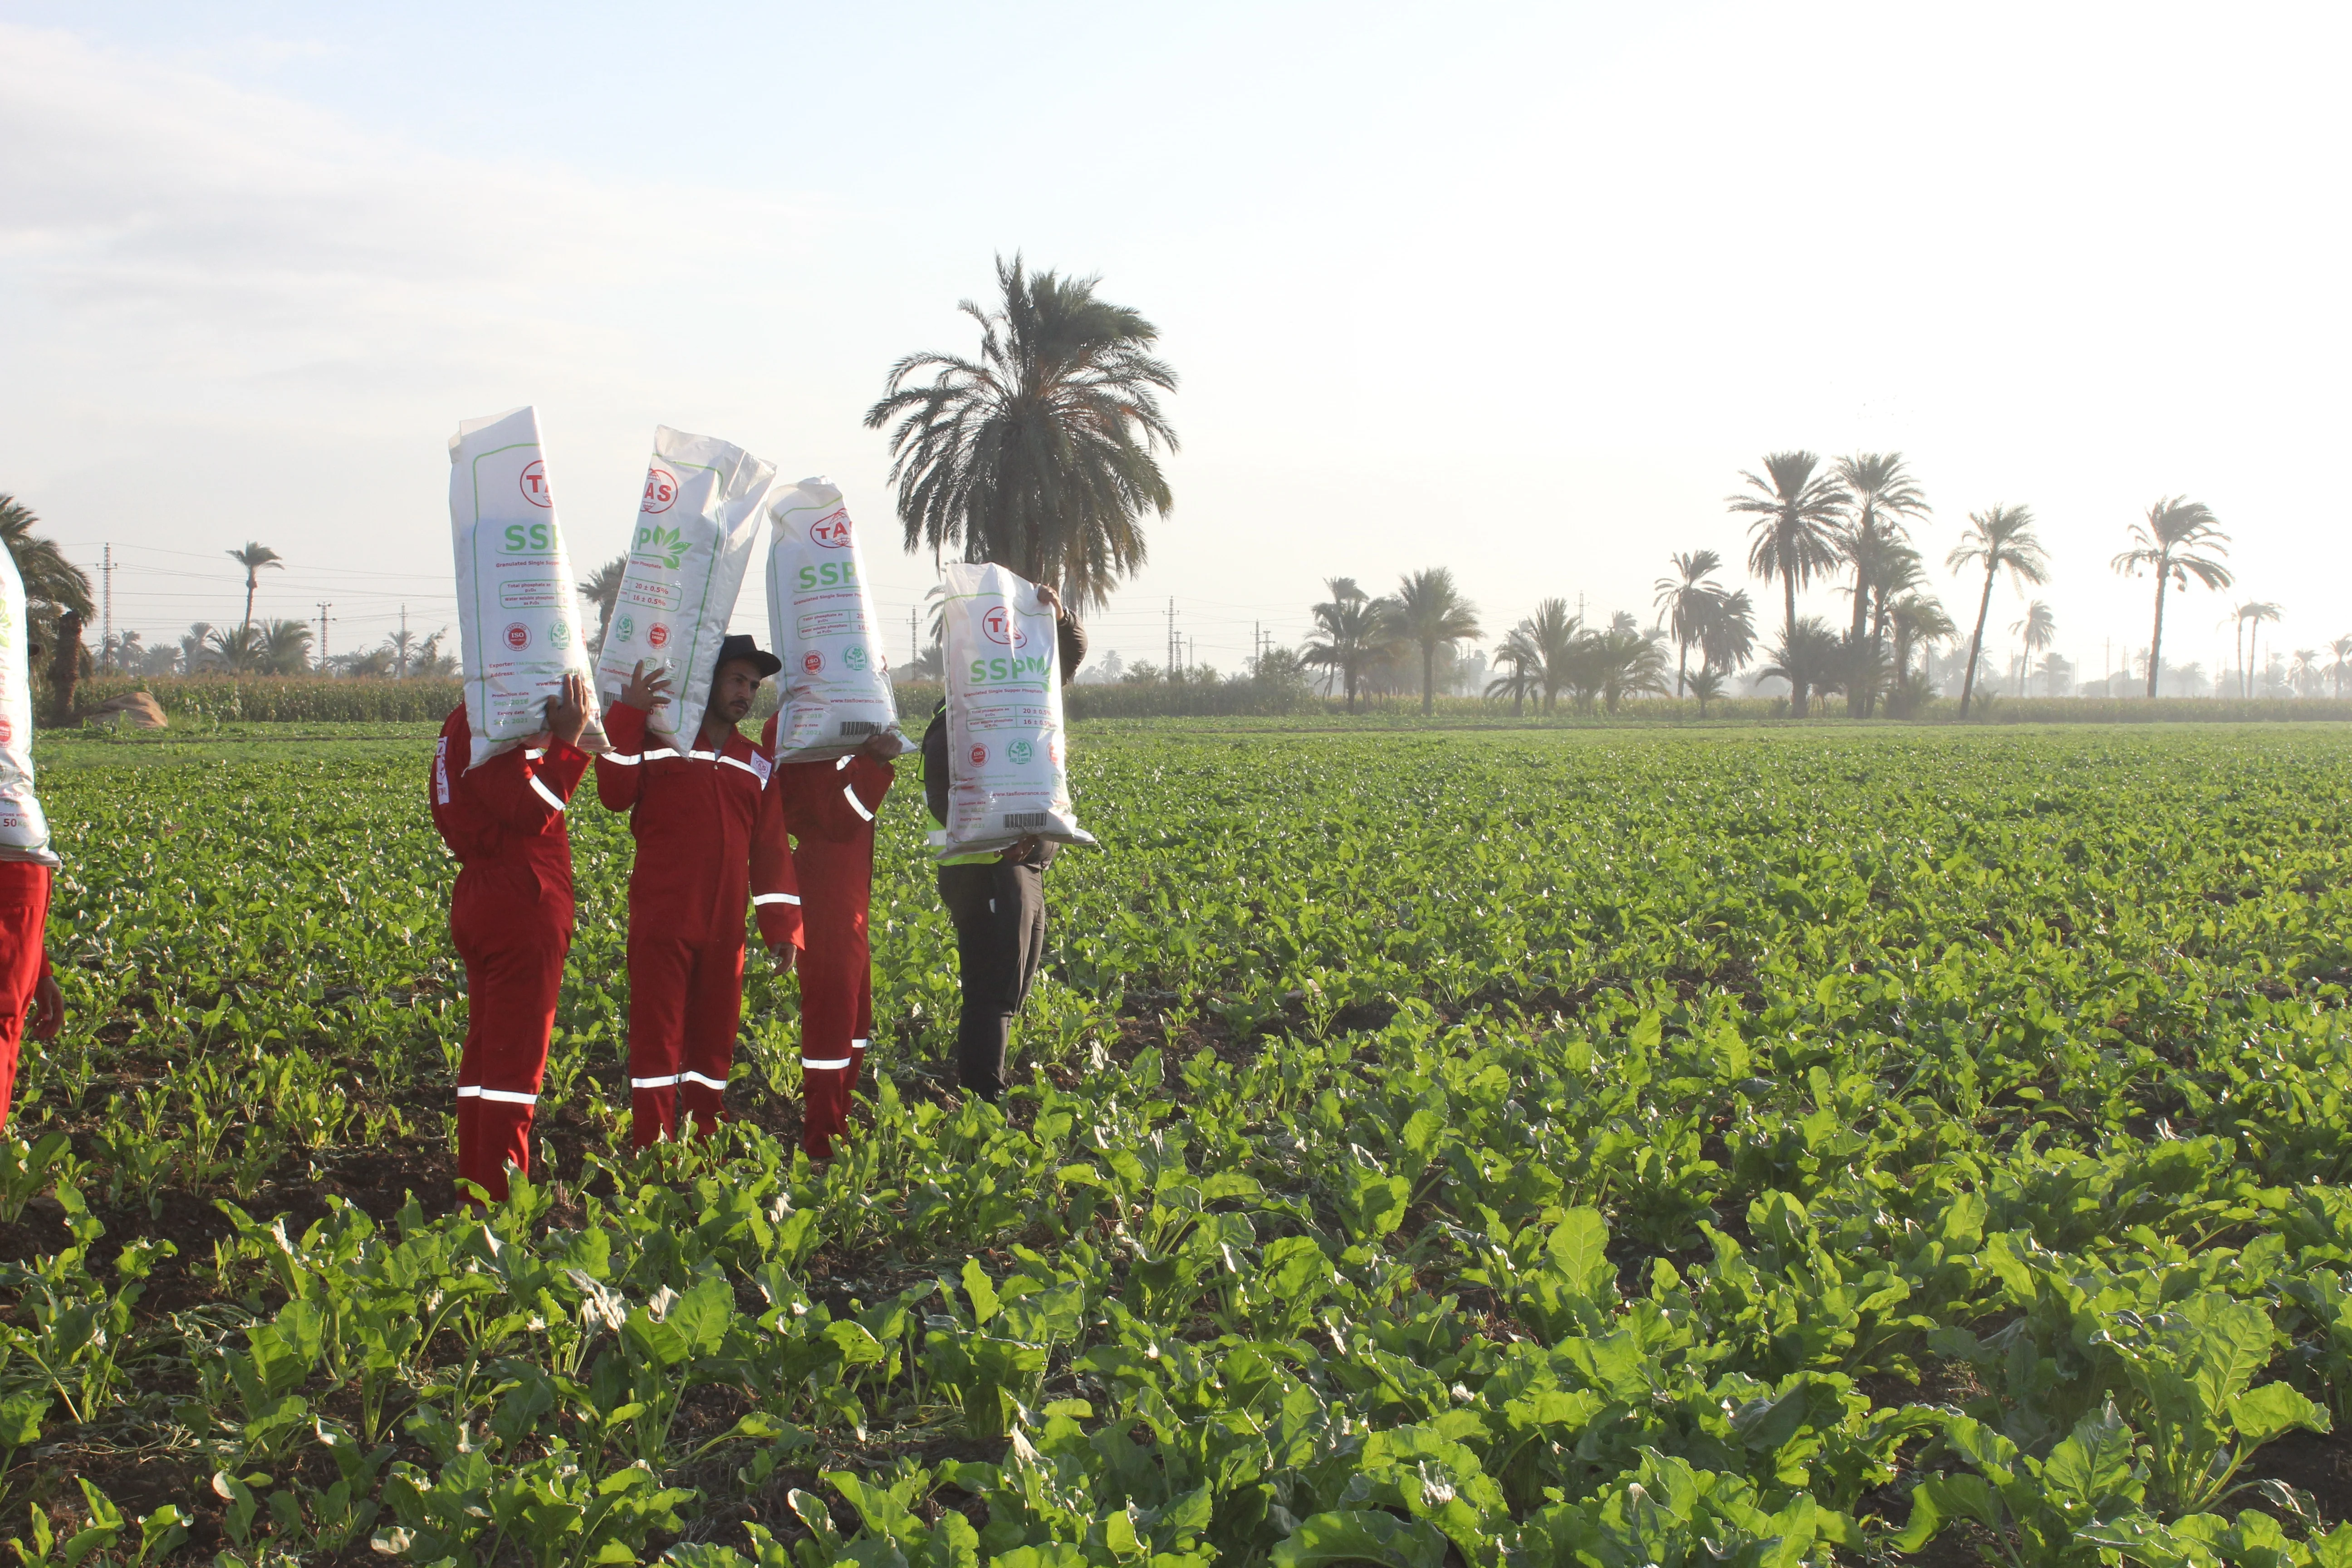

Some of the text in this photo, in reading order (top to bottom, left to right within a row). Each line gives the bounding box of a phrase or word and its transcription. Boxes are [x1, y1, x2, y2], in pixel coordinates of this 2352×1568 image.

[644, 482, 671, 502] AS
[640, 561, 662, 569] Phosphate
[799, 562, 857, 589] SSP
[650, 585, 669, 595] 0.5%
[647, 597, 666, 606] 0.5%
[794, 596, 818, 605] Granulated
[970, 658, 1026, 682] SSP
[4, 818, 17, 827] 50
